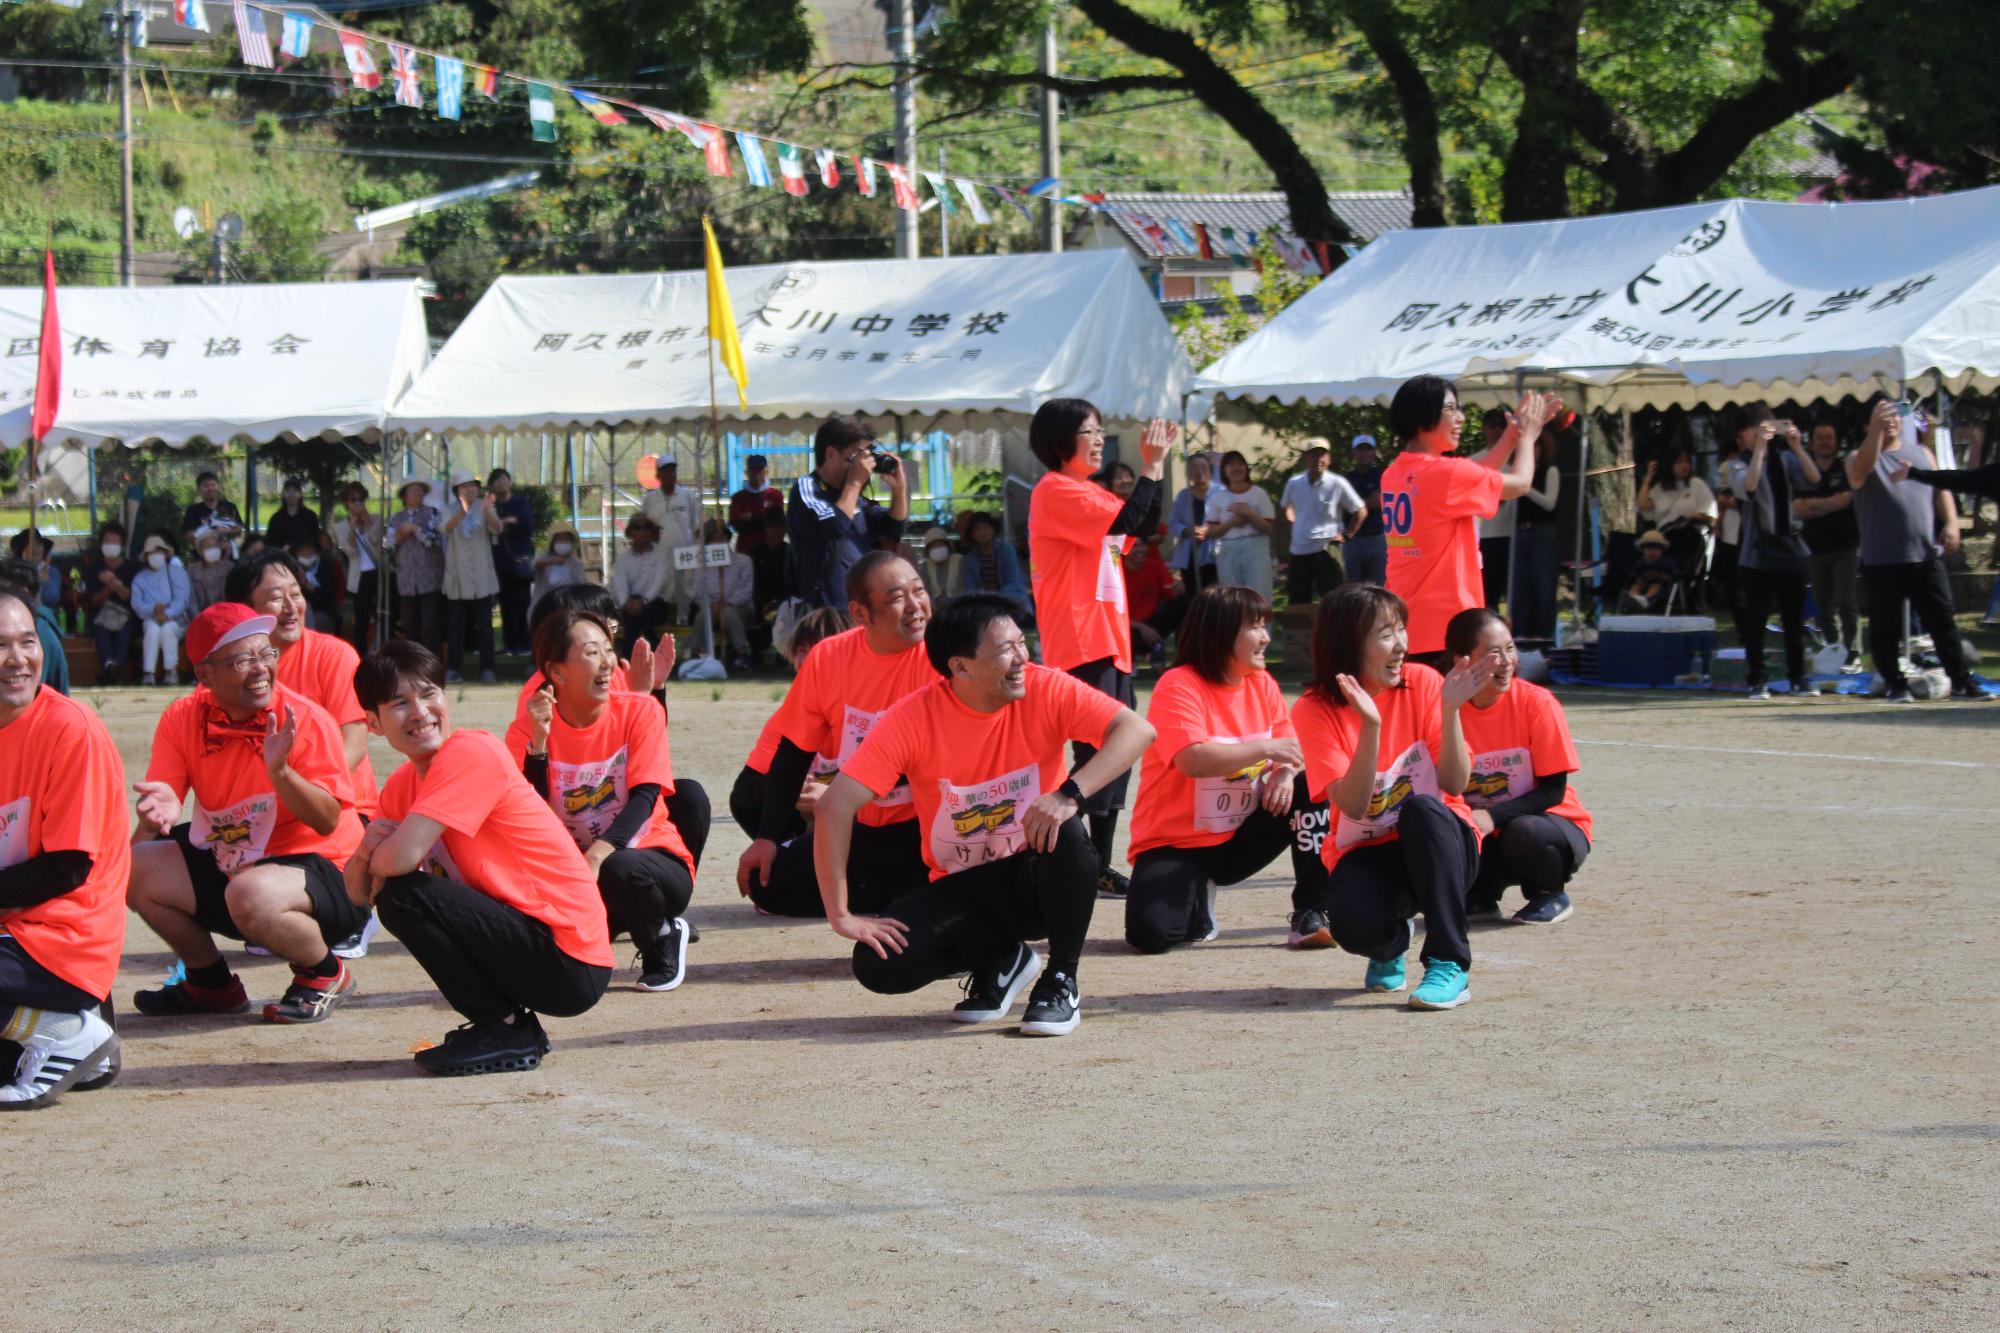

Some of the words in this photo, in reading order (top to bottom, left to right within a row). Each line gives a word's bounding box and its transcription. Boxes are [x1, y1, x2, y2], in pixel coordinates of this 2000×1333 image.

[737, 304, 1008, 337] 大川中学校
[1382, 493, 1412, 535] 50
[966, 774, 1030, 804] 華の50歳組
[1289, 809, 1330, 831] Mov
